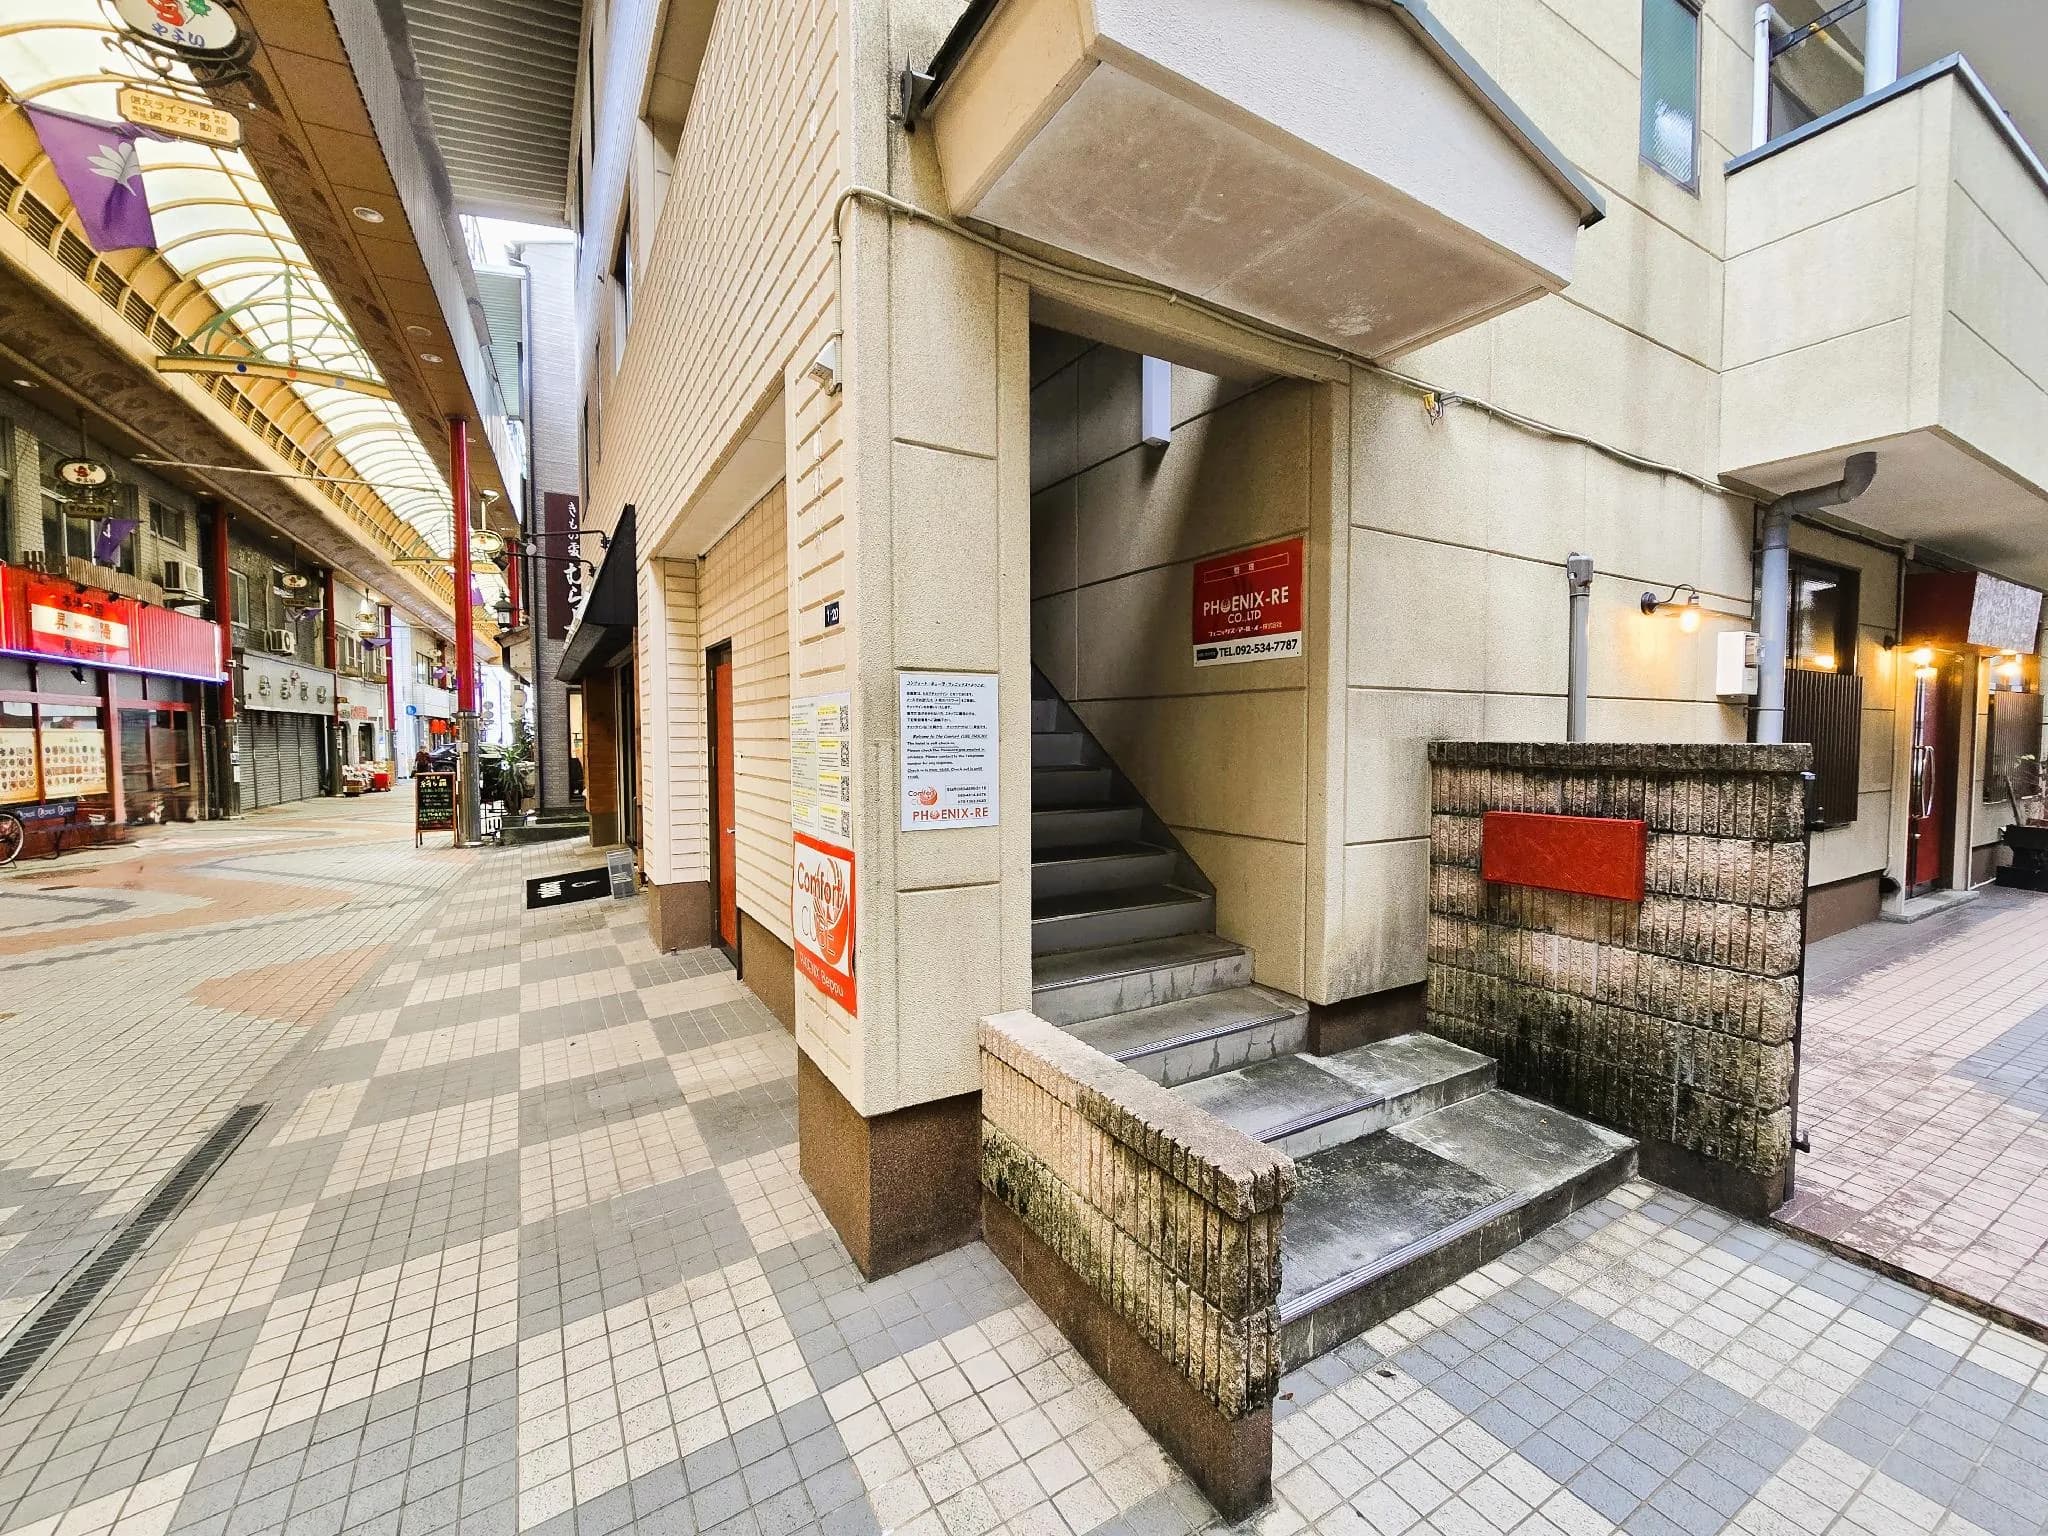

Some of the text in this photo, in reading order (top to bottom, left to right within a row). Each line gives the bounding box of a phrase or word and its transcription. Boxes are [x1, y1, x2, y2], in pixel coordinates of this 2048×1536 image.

[1203, 586, 1289, 616] PHOENIX-RE
[912, 807, 989, 821] PHOENIX-RE
[797, 862, 844, 909] Comfort
[821, 969, 845, 998] Beppu
